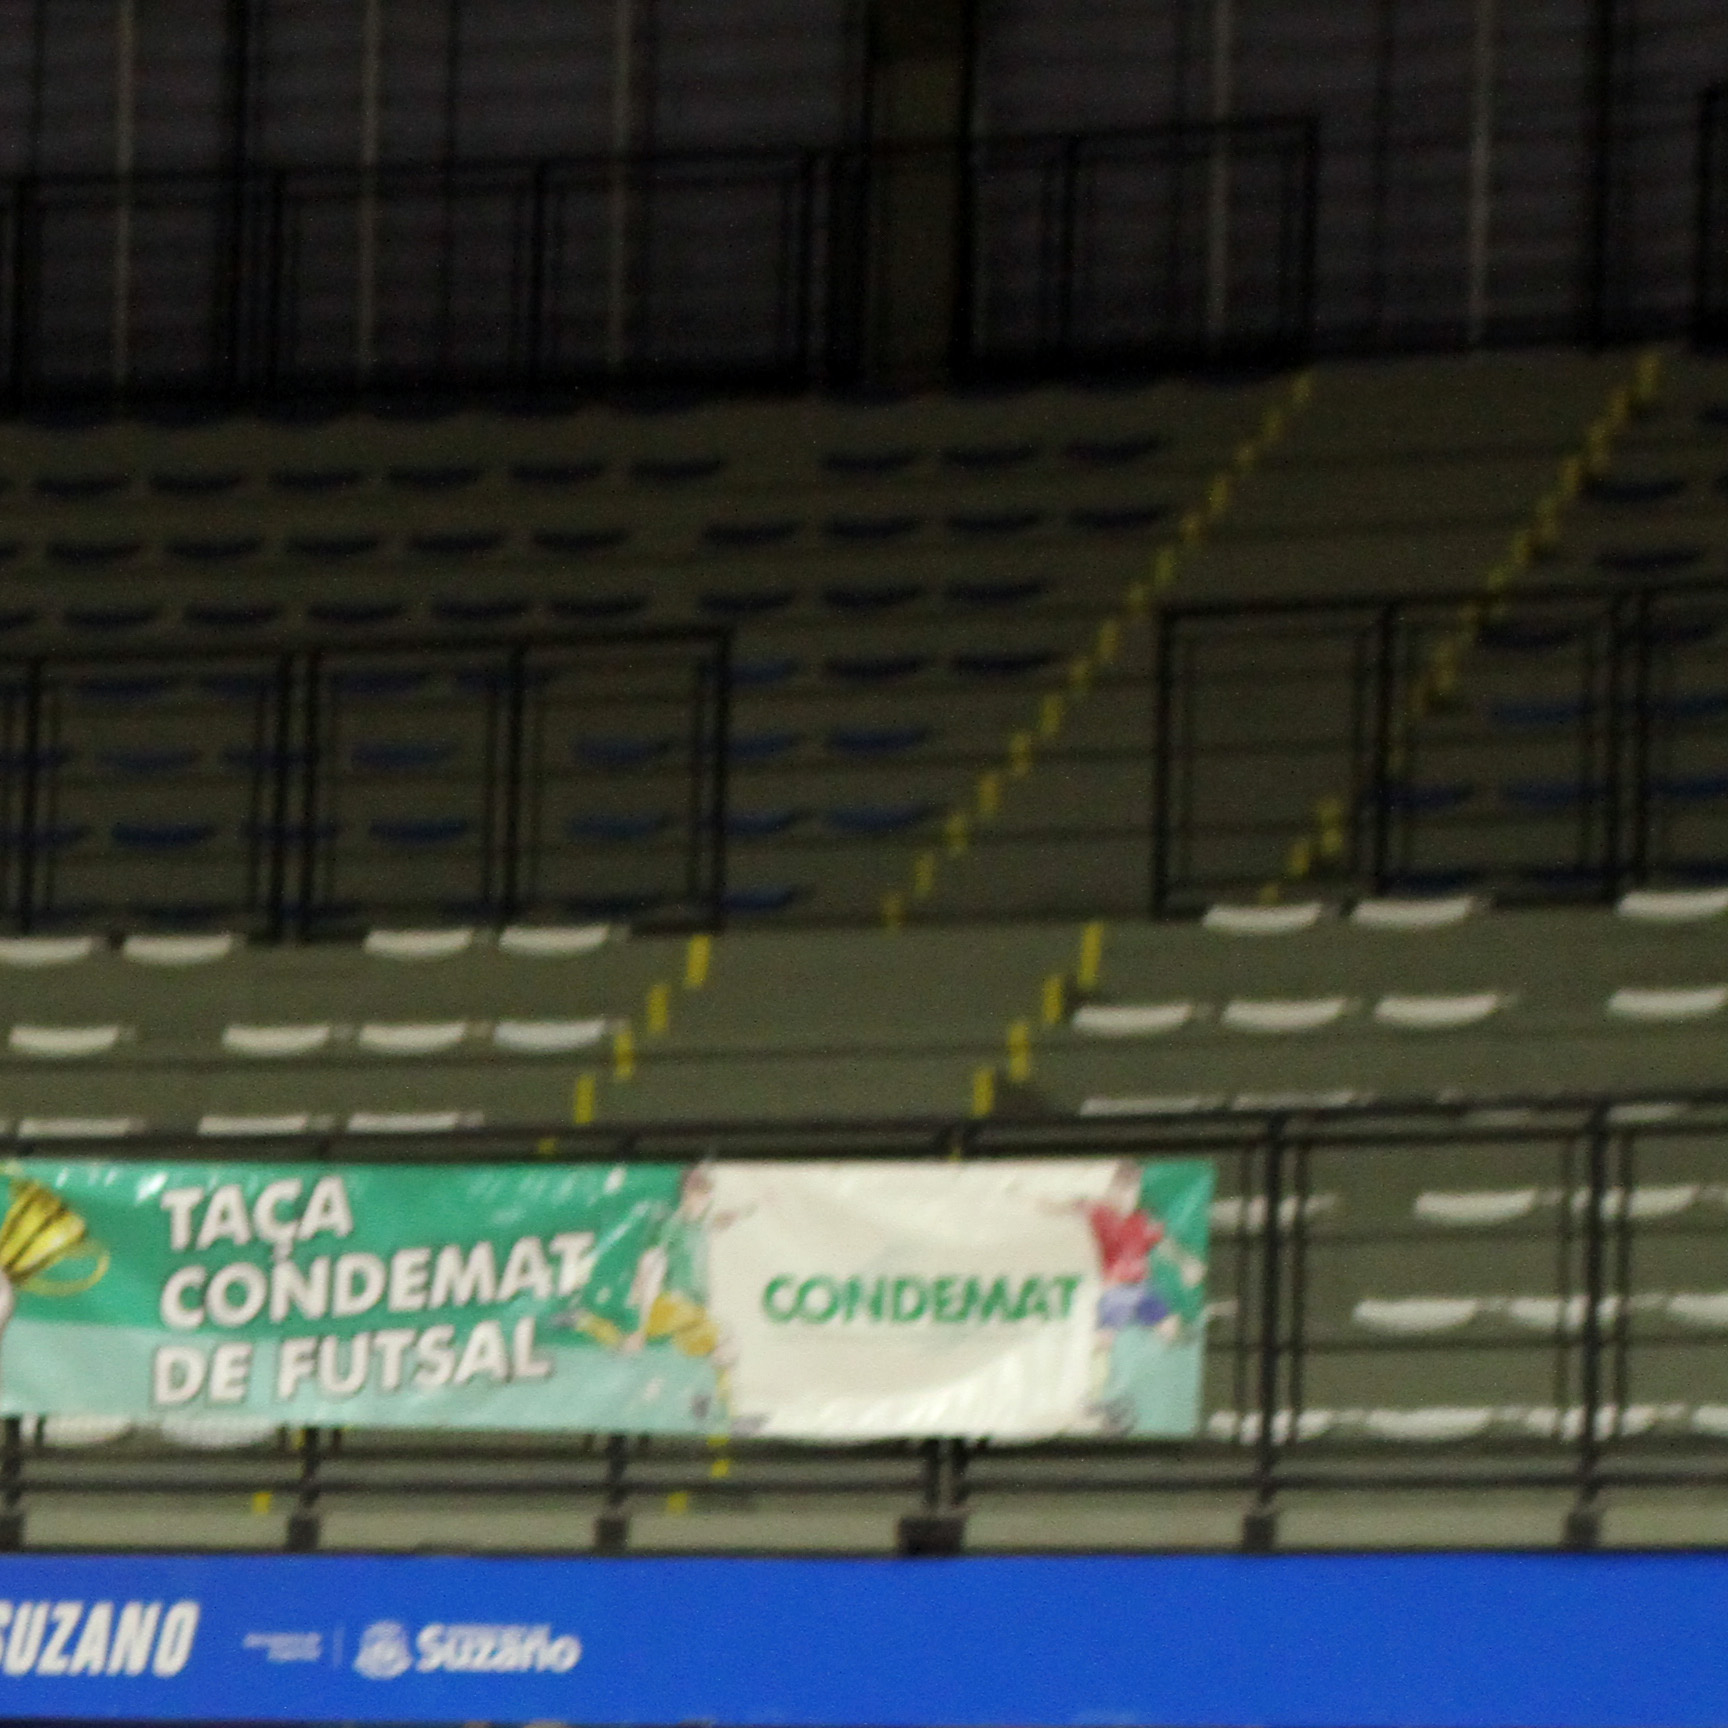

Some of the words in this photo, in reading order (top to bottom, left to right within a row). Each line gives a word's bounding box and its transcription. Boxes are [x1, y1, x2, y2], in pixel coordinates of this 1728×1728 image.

[160, 1176, 355, 1257] TAÇA
[160, 1232, 595, 1329] CONDEMAT
[761, 1274, 1082, 1323] CONDEMAT
[154, 1343, 251, 1404] DE
[278, 1317, 552, 1401] FUTSAL
[416, 1623, 582, 1673] Suzano
